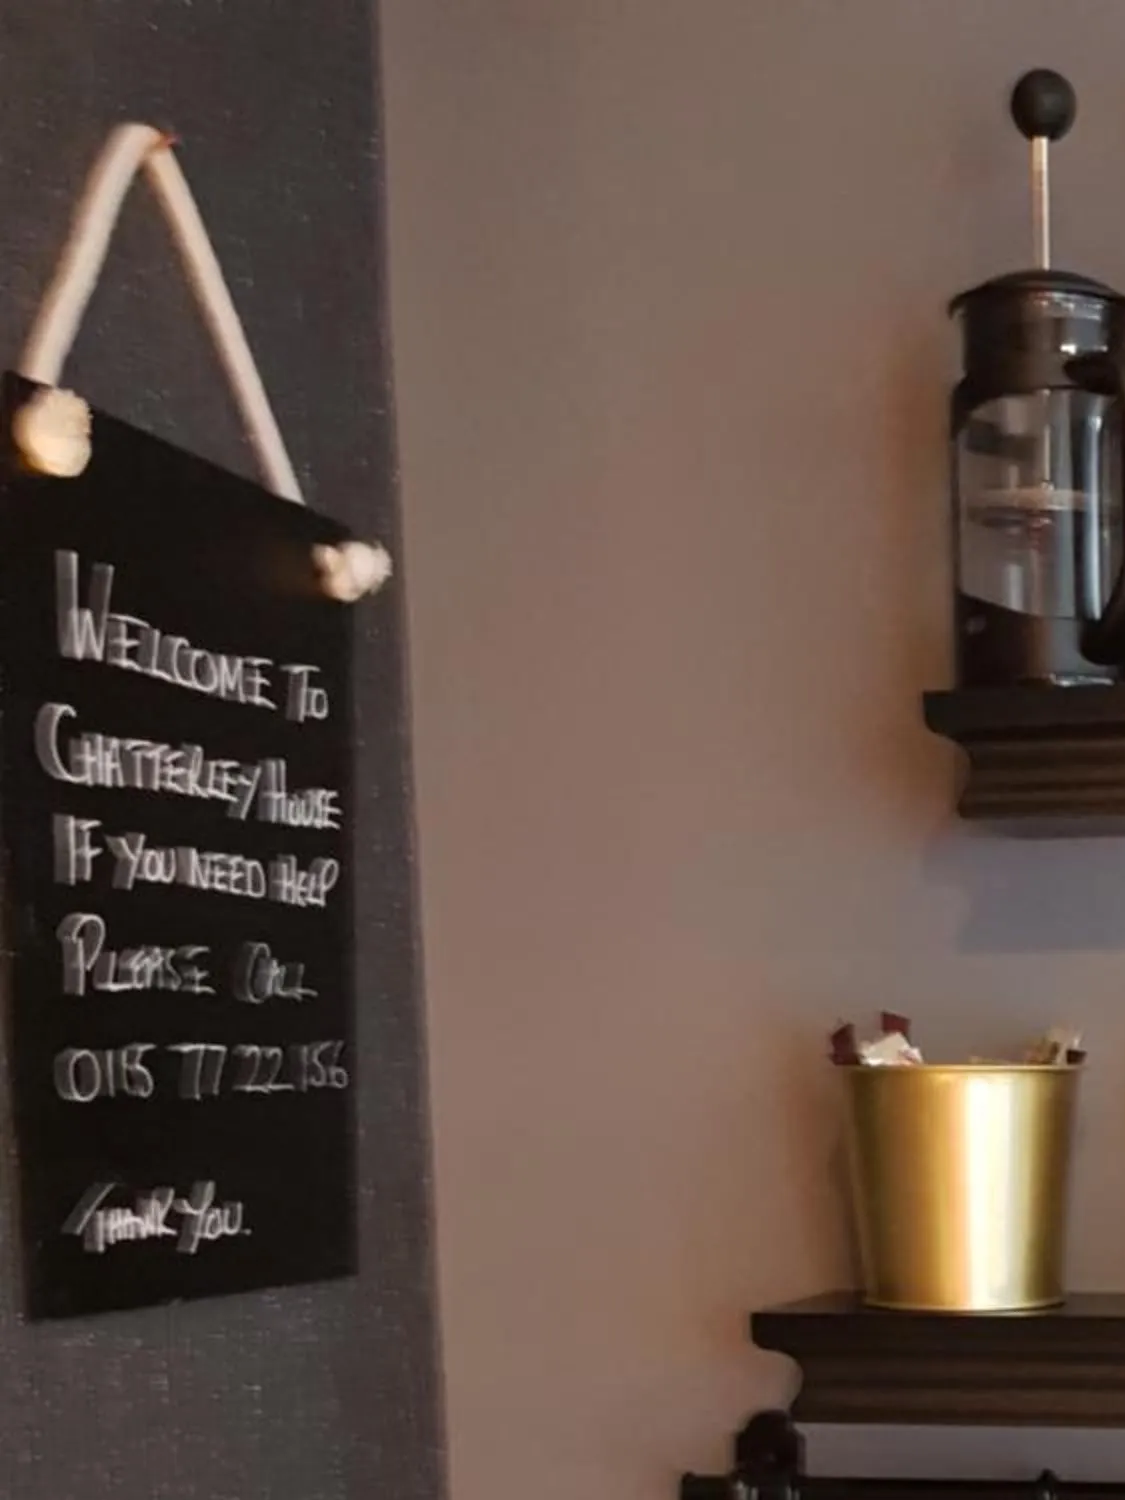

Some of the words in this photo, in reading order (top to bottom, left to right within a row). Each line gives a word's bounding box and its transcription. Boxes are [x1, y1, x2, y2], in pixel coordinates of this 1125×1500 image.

[105, 832, 176, 891] YOU
[176, 847, 267, 898] NEED
[232, 1043, 295, 1094] 22
